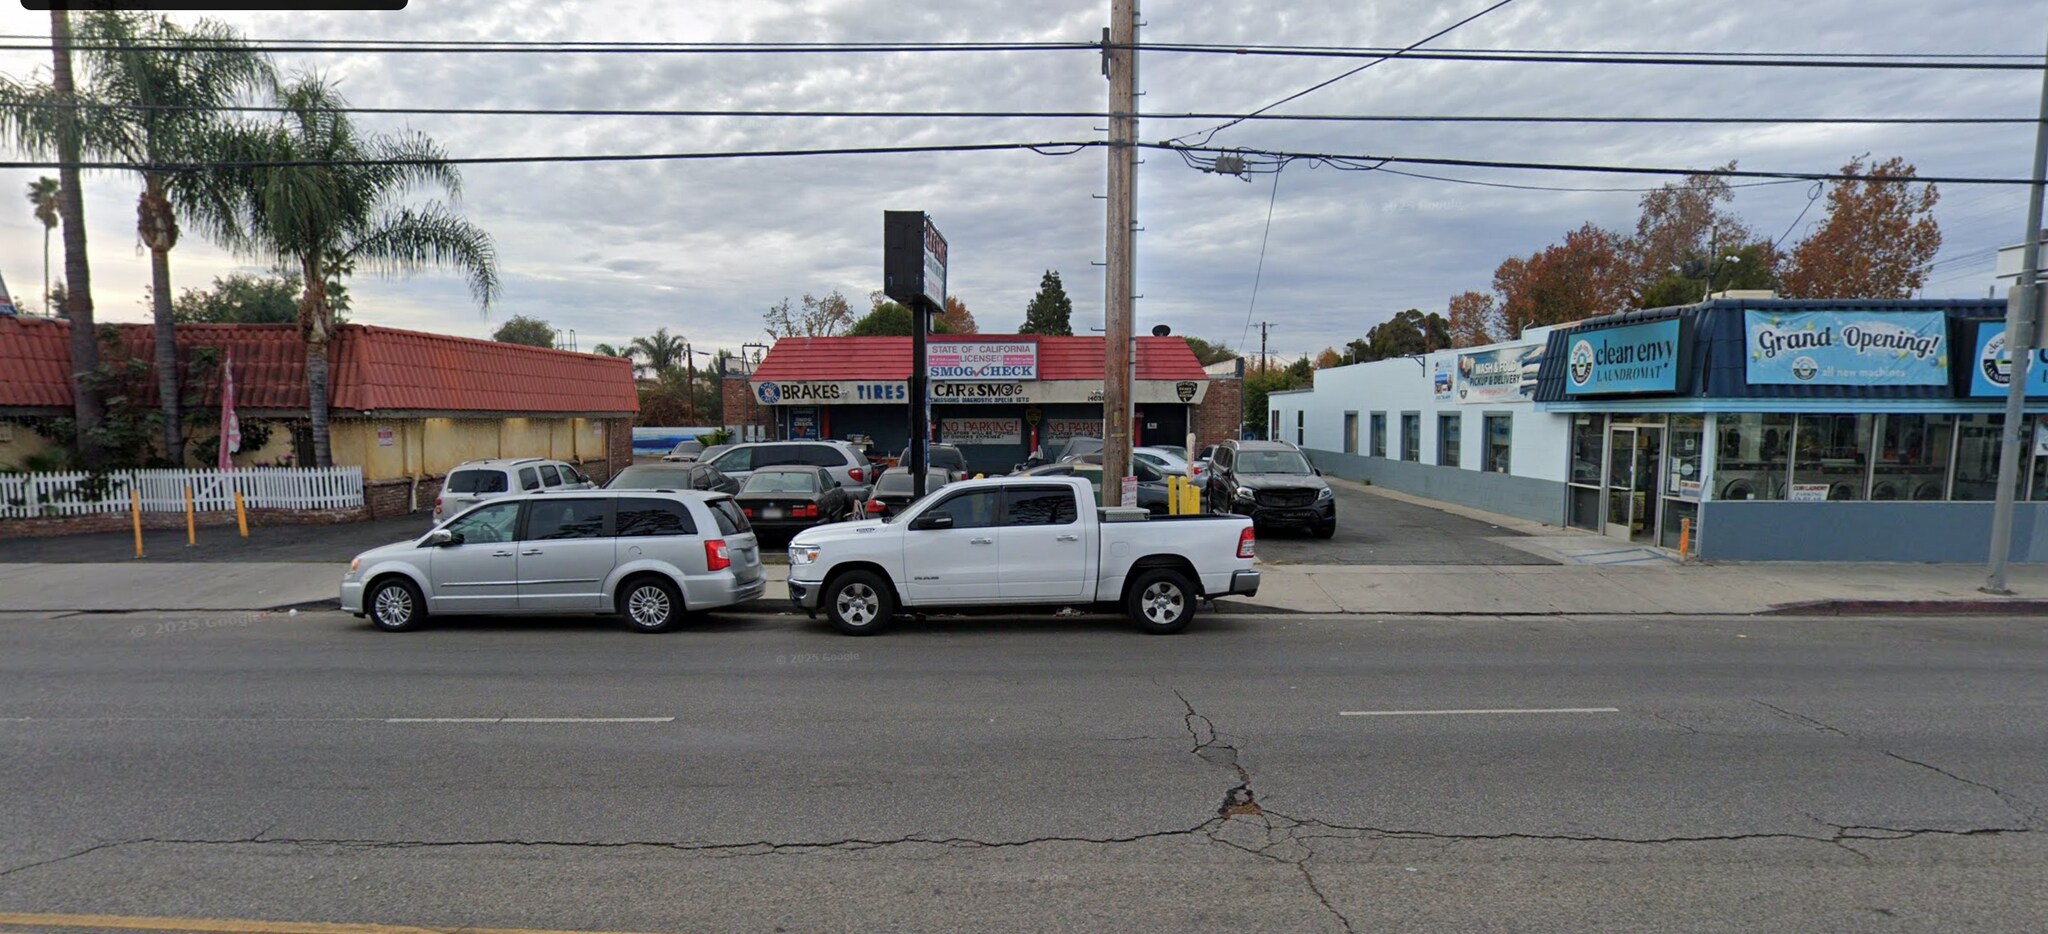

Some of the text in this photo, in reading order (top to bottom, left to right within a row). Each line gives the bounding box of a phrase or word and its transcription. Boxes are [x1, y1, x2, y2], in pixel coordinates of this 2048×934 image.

[1758, 326, 1940, 358] Grand Opening!
[932, 345, 1031, 353] STATE OF CALIFORNIA
[1595, 339, 1673, 368] clean envy
[960, 354, 1002, 363] LICENSED
[930, 366, 1033, 377] SMOG CHECK
[1597, 365, 1663, 382] LAUNDROMAT
[1822, 367, 1834, 377] all
[1836, 369, 1856, 377] new
[1859, 367, 1906, 377] machines
[1469, 377, 1488, 386] PICKUP
[1493, 374, 1520, 385] DELIVERY
[781, 384, 905, 400] BRAKES TIRES
[934, 384, 966, 397] CAR
[976, 384, 1022, 397] SMOG
[942, 421, 1018, 432] NO PARKING!
[1049, 422, 1065, 432] NO
